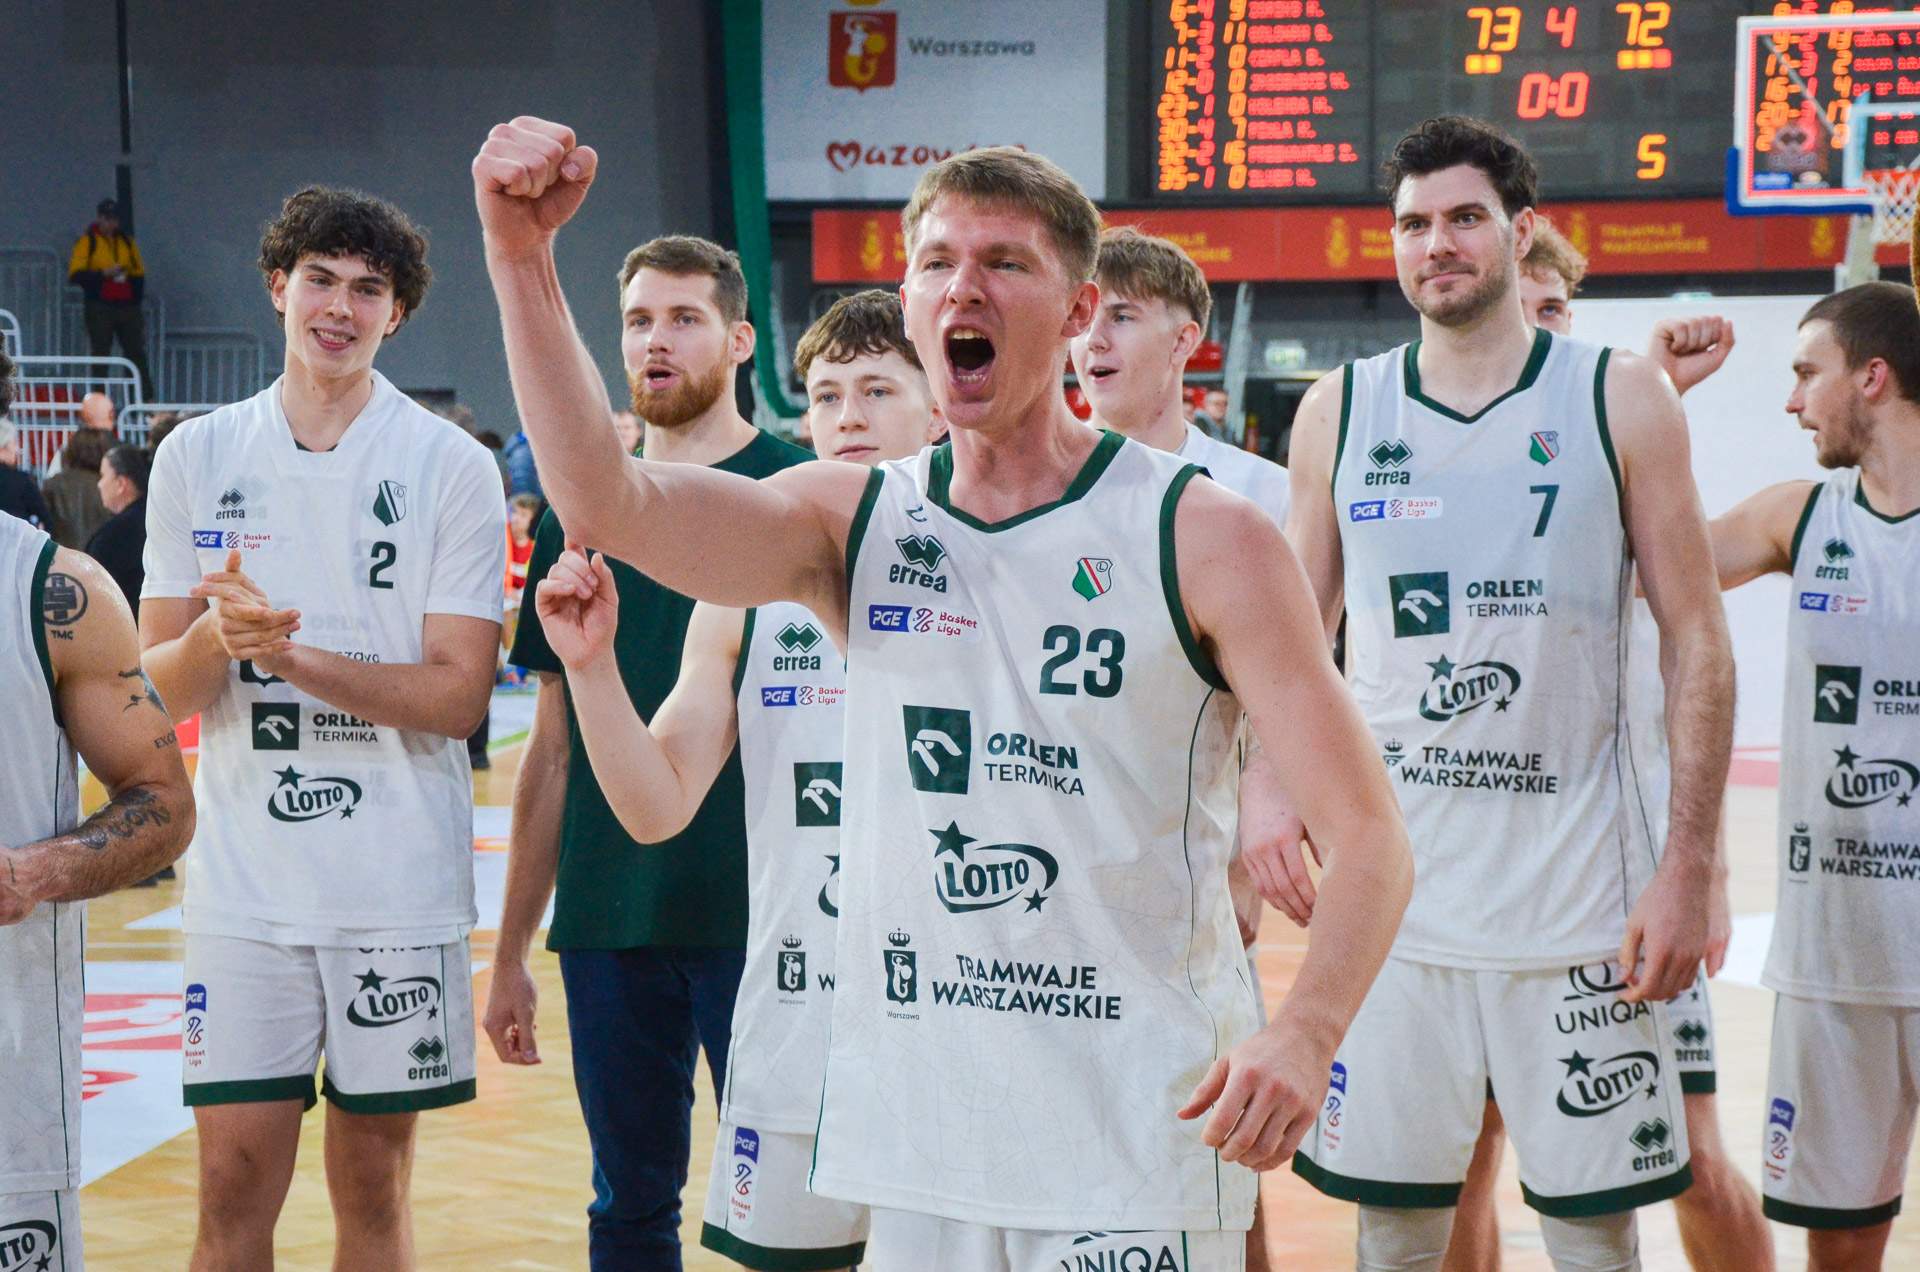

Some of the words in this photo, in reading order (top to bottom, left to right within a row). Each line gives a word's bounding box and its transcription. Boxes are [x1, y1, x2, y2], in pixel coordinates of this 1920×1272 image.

[1466, 6, 1522, 52] 73
[1545, 6, 1577, 48] 4
[1615, 2, 1671, 47] 72
[908, 37, 1036, 57] Warszawa
[1517, 71, 1590, 120] 0:0
[1635, 133, 1667, 180] 5
[1365, 470, 1410, 486] errea
[215, 508, 245, 520] errea
[1353, 503, 1381, 518] PGE
[1529, 484, 1560, 538] 7
[243, 533, 271, 541] Basket
[243, 541, 261, 549] Liga
[369, 541, 397, 589] 2
[888, 563, 947, 594] errea
[1466, 578, 1543, 599] ORLEN
[872, 609, 904, 627] PGE
[939, 611, 978, 630] Basket
[1466, 602, 1549, 618] TERMIKA
[937, 622, 961, 636] Liga
[773, 655, 821, 671] errea
[1039, 624, 1126, 699] 23
[764, 690, 791, 703] PGE
[818, 696, 836, 705] Liga
[1439, 672, 1500, 710] LOTTO
[313, 730, 378, 743] TERMIKA
[986, 733, 1078, 770] ORLEN
[1422, 746, 1543, 773] TRAMWAJE
[983, 763, 1085, 797] TERMIKA
[1401, 766, 1558, 794] WARSZAWSKIE
[1840, 769, 1900, 798] LOTTO
[285, 786, 344, 814] LOTTO
[943, 858, 1030, 898] LOTTO
[1820, 857, 1920, 880] WARSZAW
[955, 954, 1097, 990] TRAMWAJE
[366, 986, 429, 1018] LOTTO
[932, 981, 1121, 1020] WARSZAWSKIE
[886, 1010, 920, 1021] Warszawa
[1555, 999, 1651, 1034] UNIQA
[408, 1062, 448, 1080] errea
[1576, 1062, 1644, 1106] LOTTO
[1632, 1149, 1675, 1172] errea
